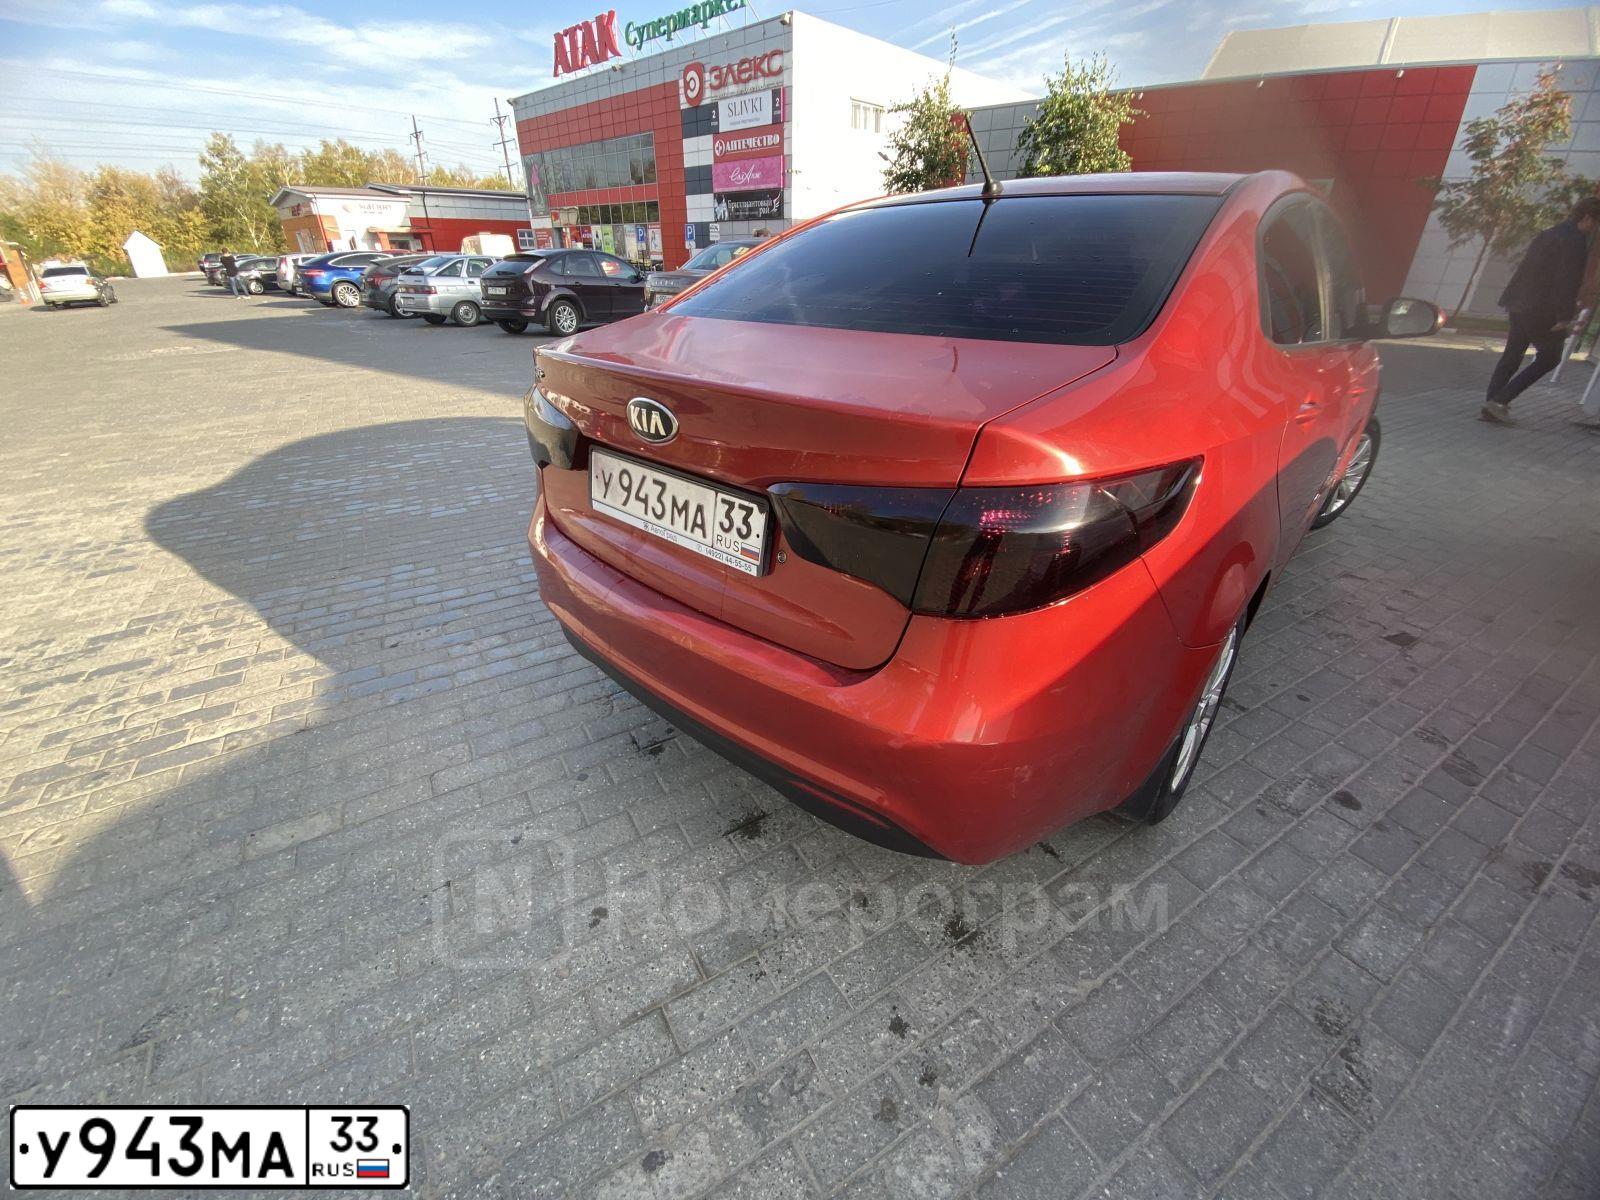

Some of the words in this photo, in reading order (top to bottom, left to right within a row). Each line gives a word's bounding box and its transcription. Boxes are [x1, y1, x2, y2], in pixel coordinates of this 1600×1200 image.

[553, 9, 622, 77] АТАК
[727, 97, 763, 118] SLIVKI
[725, 133, 780, 152] АПТЕЧЕСТВО
[629, 404, 667, 436] KIA
[601, 468, 707, 539] У943МА
[719, 498, 754, 541] 33
[716, 534, 740, 553] RUS
[705, 547, 724, 562] (4922)
[725, 556, 752, 572] 44-55-55
